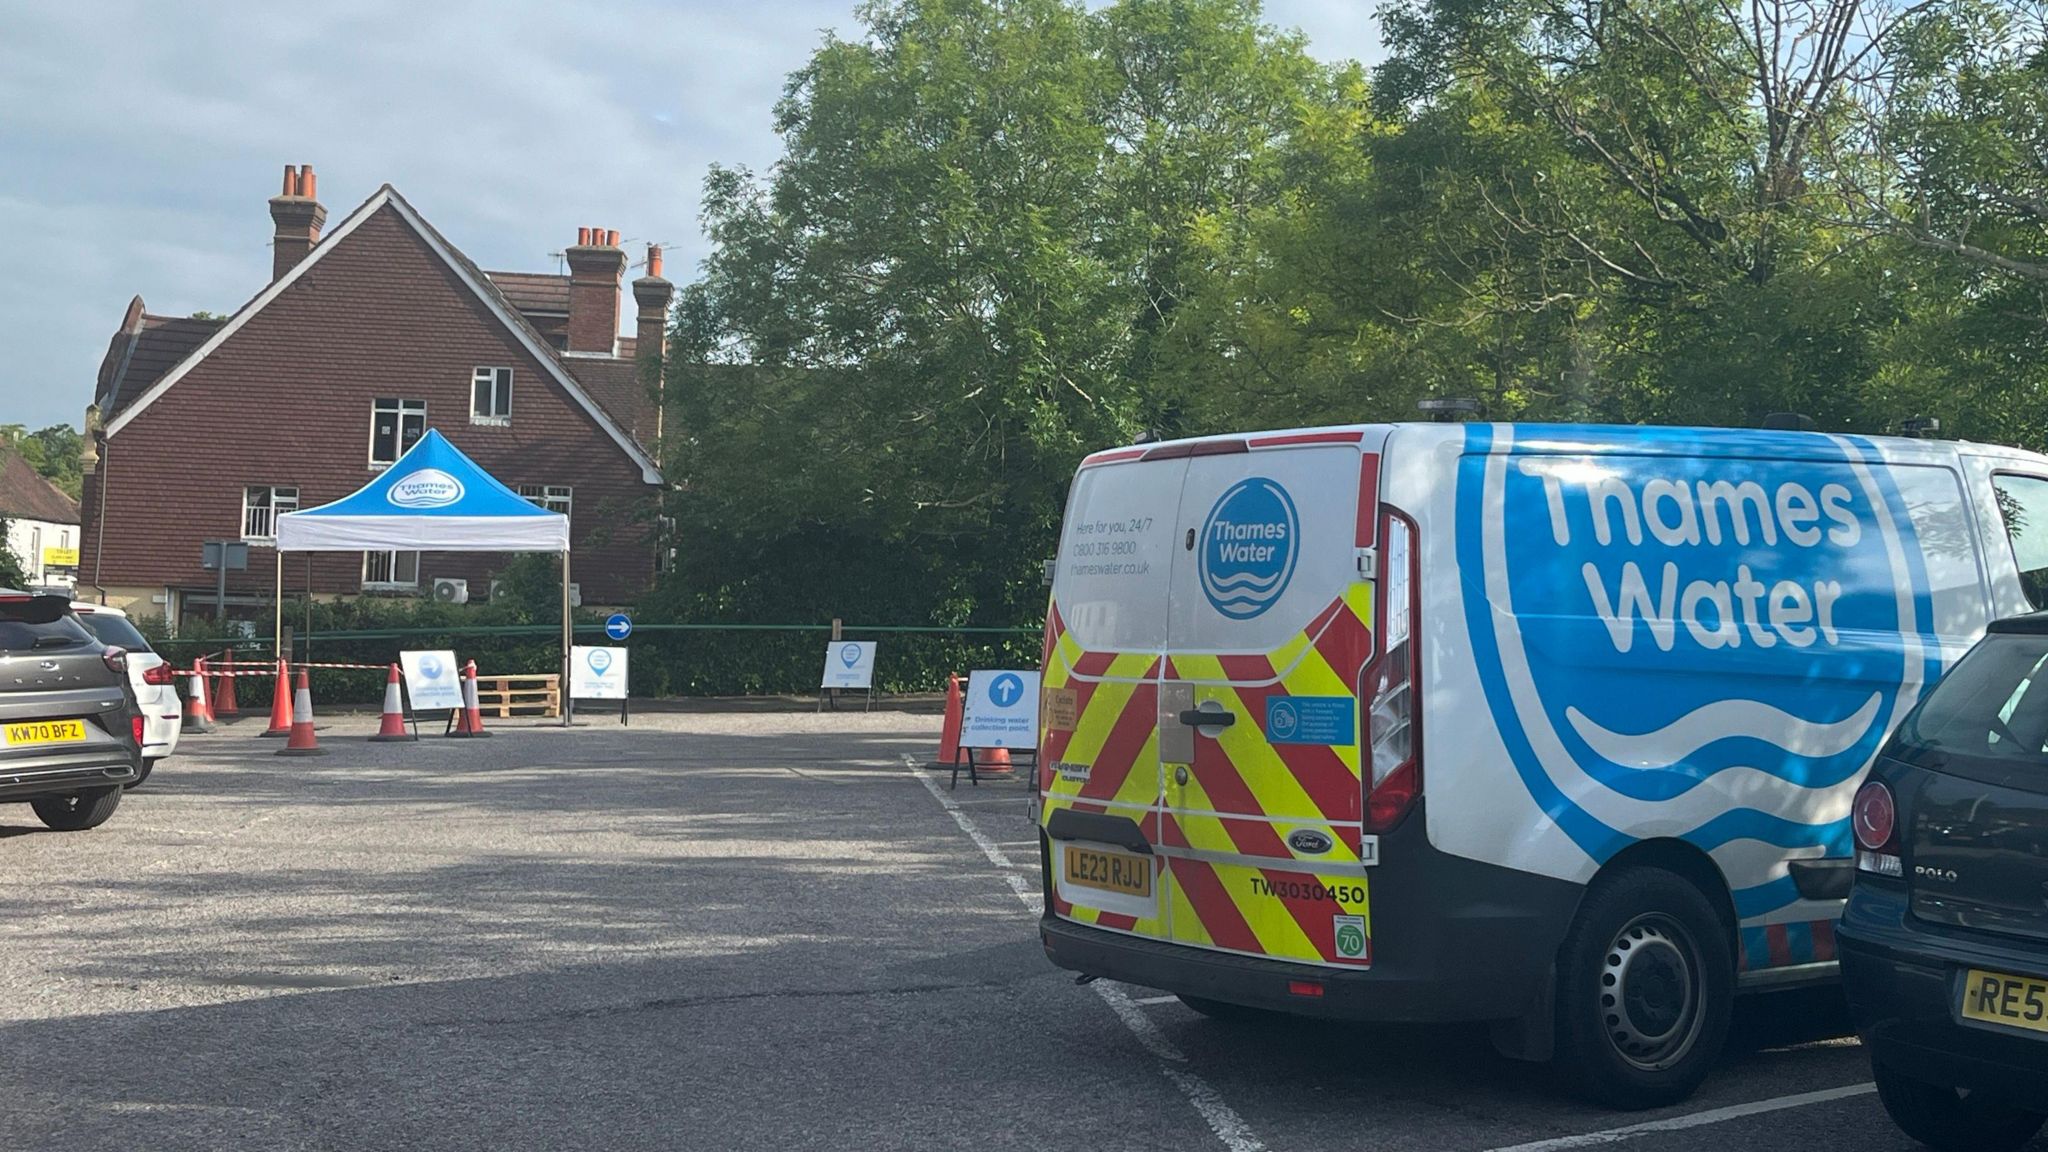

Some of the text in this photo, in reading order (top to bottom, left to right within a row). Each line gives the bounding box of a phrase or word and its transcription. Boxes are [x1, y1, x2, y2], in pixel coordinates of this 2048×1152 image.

[400, 482, 454, 491] Thames
[404, 488, 447, 496] Water
[1518, 458, 1861, 547] Thames
[1077, 518, 1152, 535] Here for you, 24/7
[1214, 521, 1287, 541] Thames
[1073, 541, 1137, 557] 0800 316 9800
[1220, 543, 1276, 563] Water
[1582, 561, 1842, 653] Water
[975, 716, 1006, 725] Drinking
[11, 723, 79, 742] KW70 BFZ
[1295, 835, 1320, 849] Ford
[1069, 851, 1143, 889] LE23 RJJ
[1915, 865, 1957, 882] POLO
[1250, 878, 1365, 904] TW3030450
[1341, 934, 1360, 952] 70
[1978, 977, 2048, 1021] RE5
